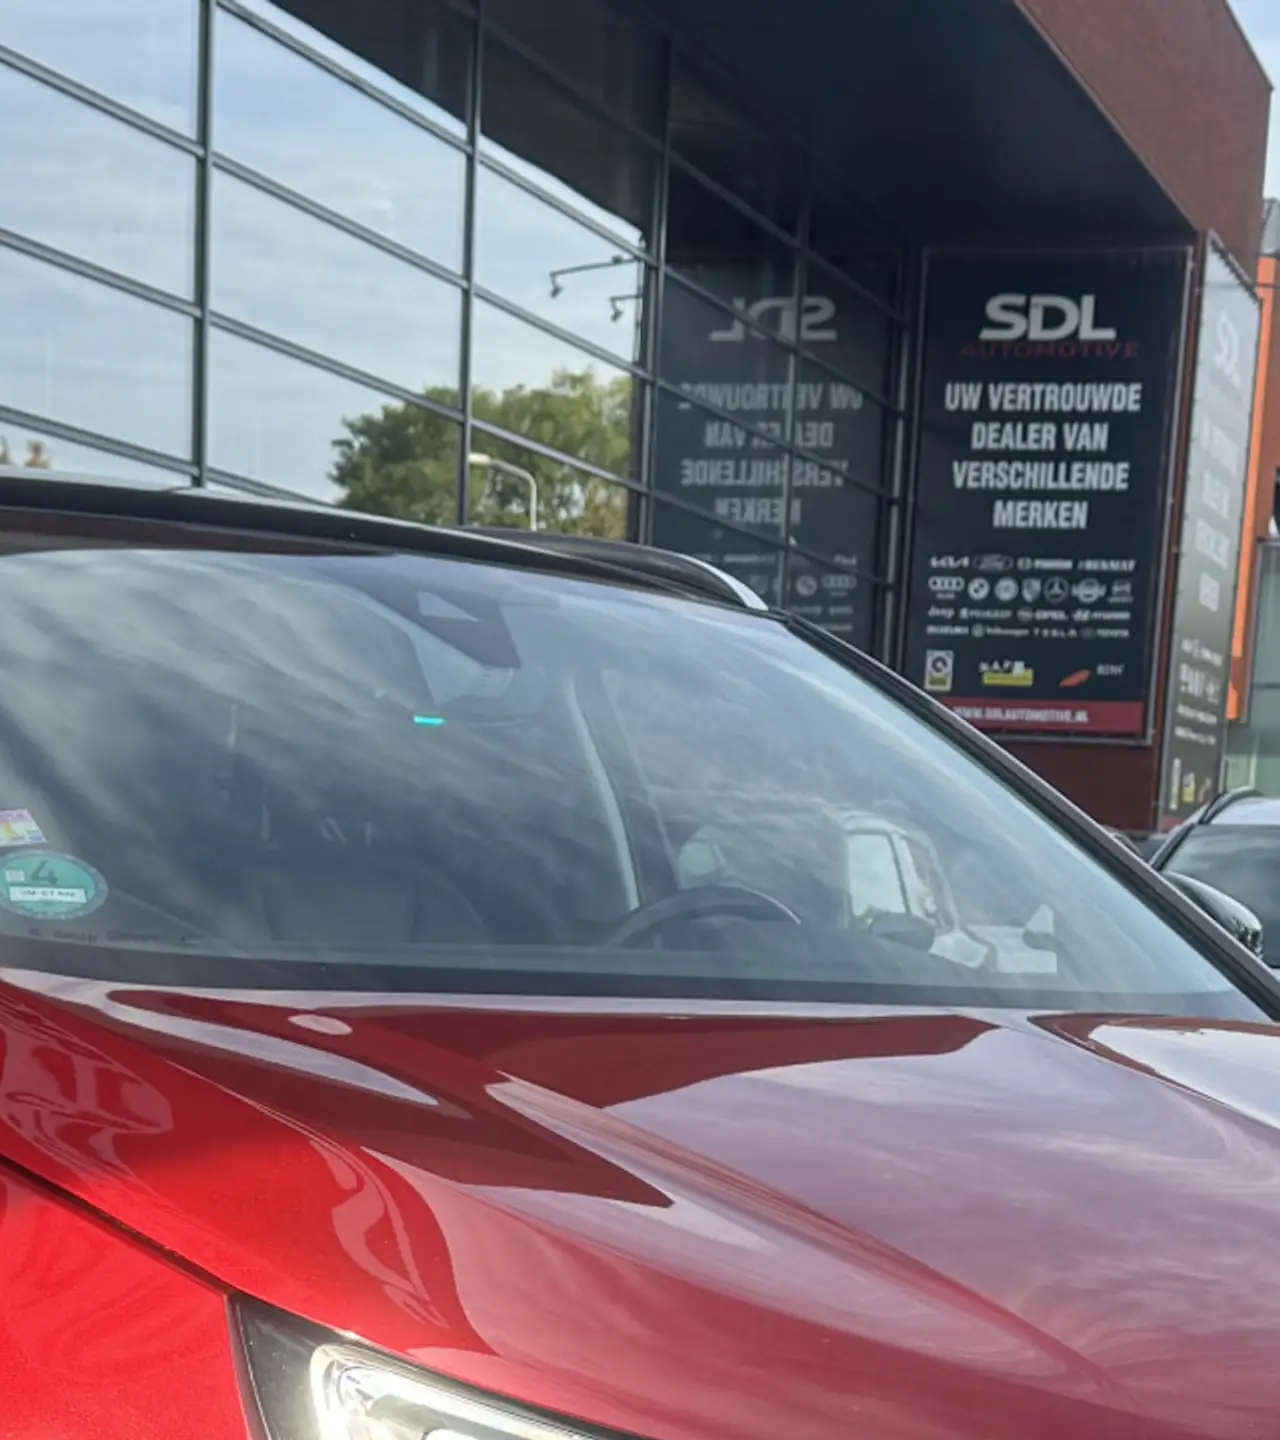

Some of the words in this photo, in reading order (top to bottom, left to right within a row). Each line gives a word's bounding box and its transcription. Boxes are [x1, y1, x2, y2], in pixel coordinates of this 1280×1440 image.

[978, 292, 1117, 341] SDL
[960, 341, 1139, 359] AUTOMOTIVE
[944, 383, 983, 412] UW
[988, 382, 1142, 412] VERTROUWDE
[971, 421, 1057, 451] DEALER
[1063, 421, 1109, 452] VAN
[953, 459, 1130, 490] VERSCHILLENDE
[992, 499, 1088, 529] MERKEN
[31, 860, 59, 885] 4
